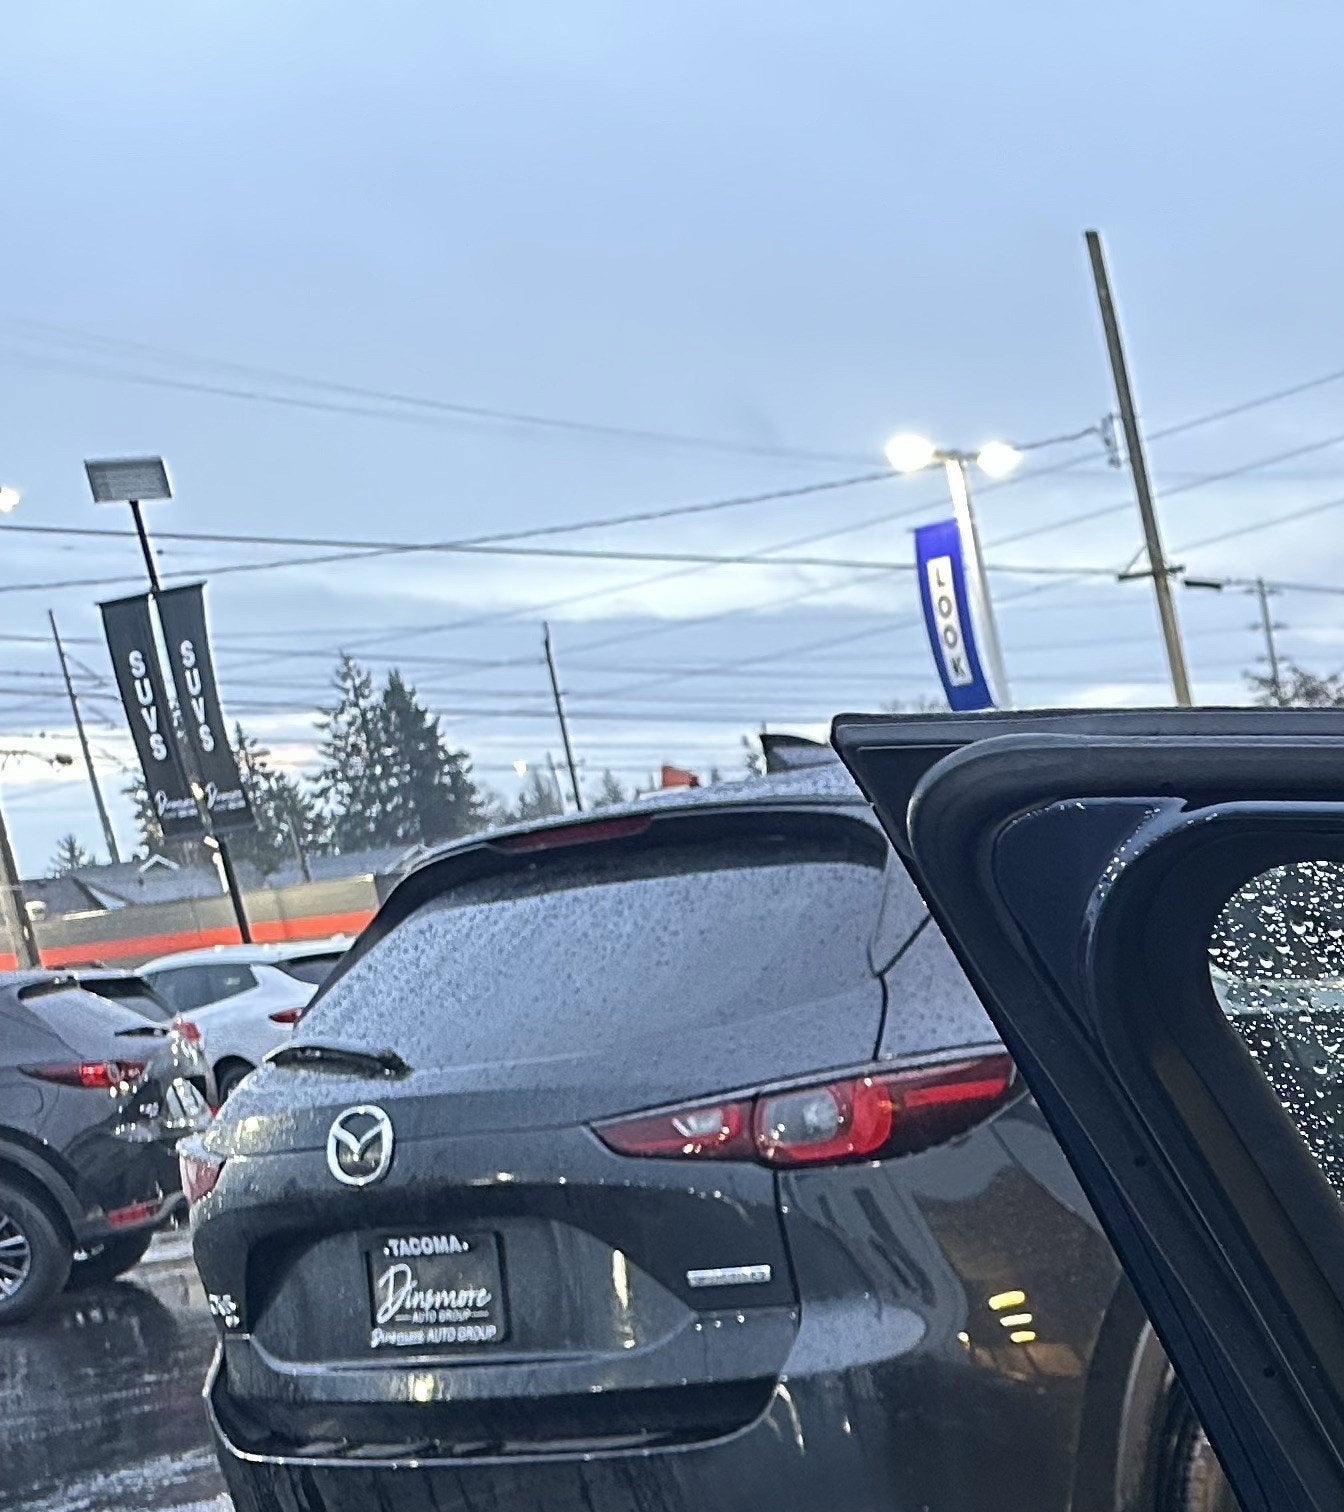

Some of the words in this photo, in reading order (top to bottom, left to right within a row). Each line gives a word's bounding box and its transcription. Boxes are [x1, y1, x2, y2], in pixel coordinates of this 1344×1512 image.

[935, 566, 966, 677] LOOK
[128, 649, 168, 762] SUVS
[179, 639, 215, 753] SUVS
[388, 1234, 462, 1257] TACOMA
[376, 1263, 492, 1324] Dinsmore
[412, 1309, 437, 1323] AUTO
[426, 1326, 457, 1343] AUTO
[457, 1324, 497, 1342] GROUP
